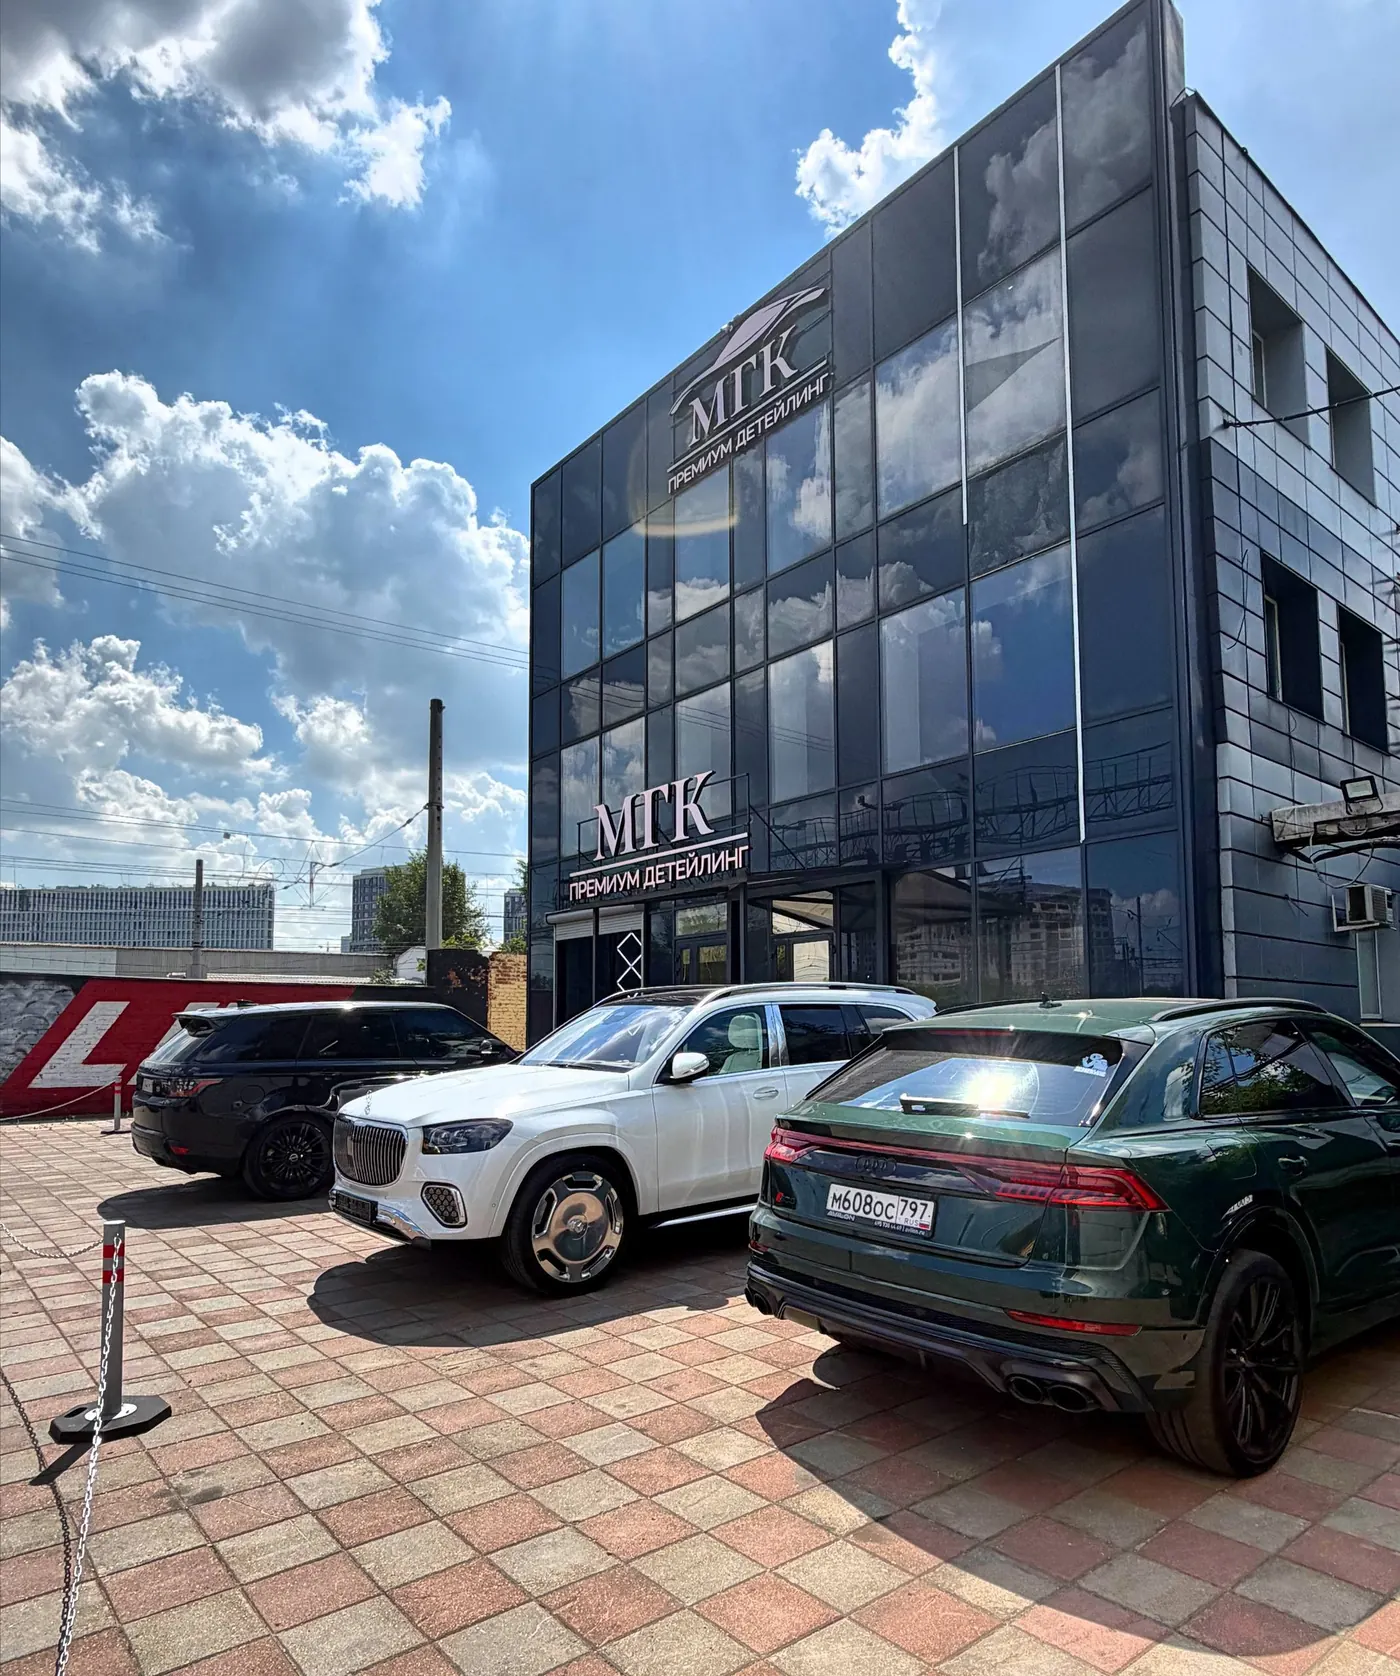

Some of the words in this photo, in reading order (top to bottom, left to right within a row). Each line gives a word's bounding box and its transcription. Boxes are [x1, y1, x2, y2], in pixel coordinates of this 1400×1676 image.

[688, 324, 798, 447] МГК
[668, 437, 732, 494] ПРЕМИУМ
[735, 373, 829, 451] ДЕТЕЙЛИНГ
[593, 770, 716, 861] МГК
[569, 869, 639, 901] ПРЕМИУМ
[643, 845, 749, 889] ДЕТЕЙЛИНГ
[900, 1198, 929, 1219] 797
[904, 1217, 919, 1227] RUS
